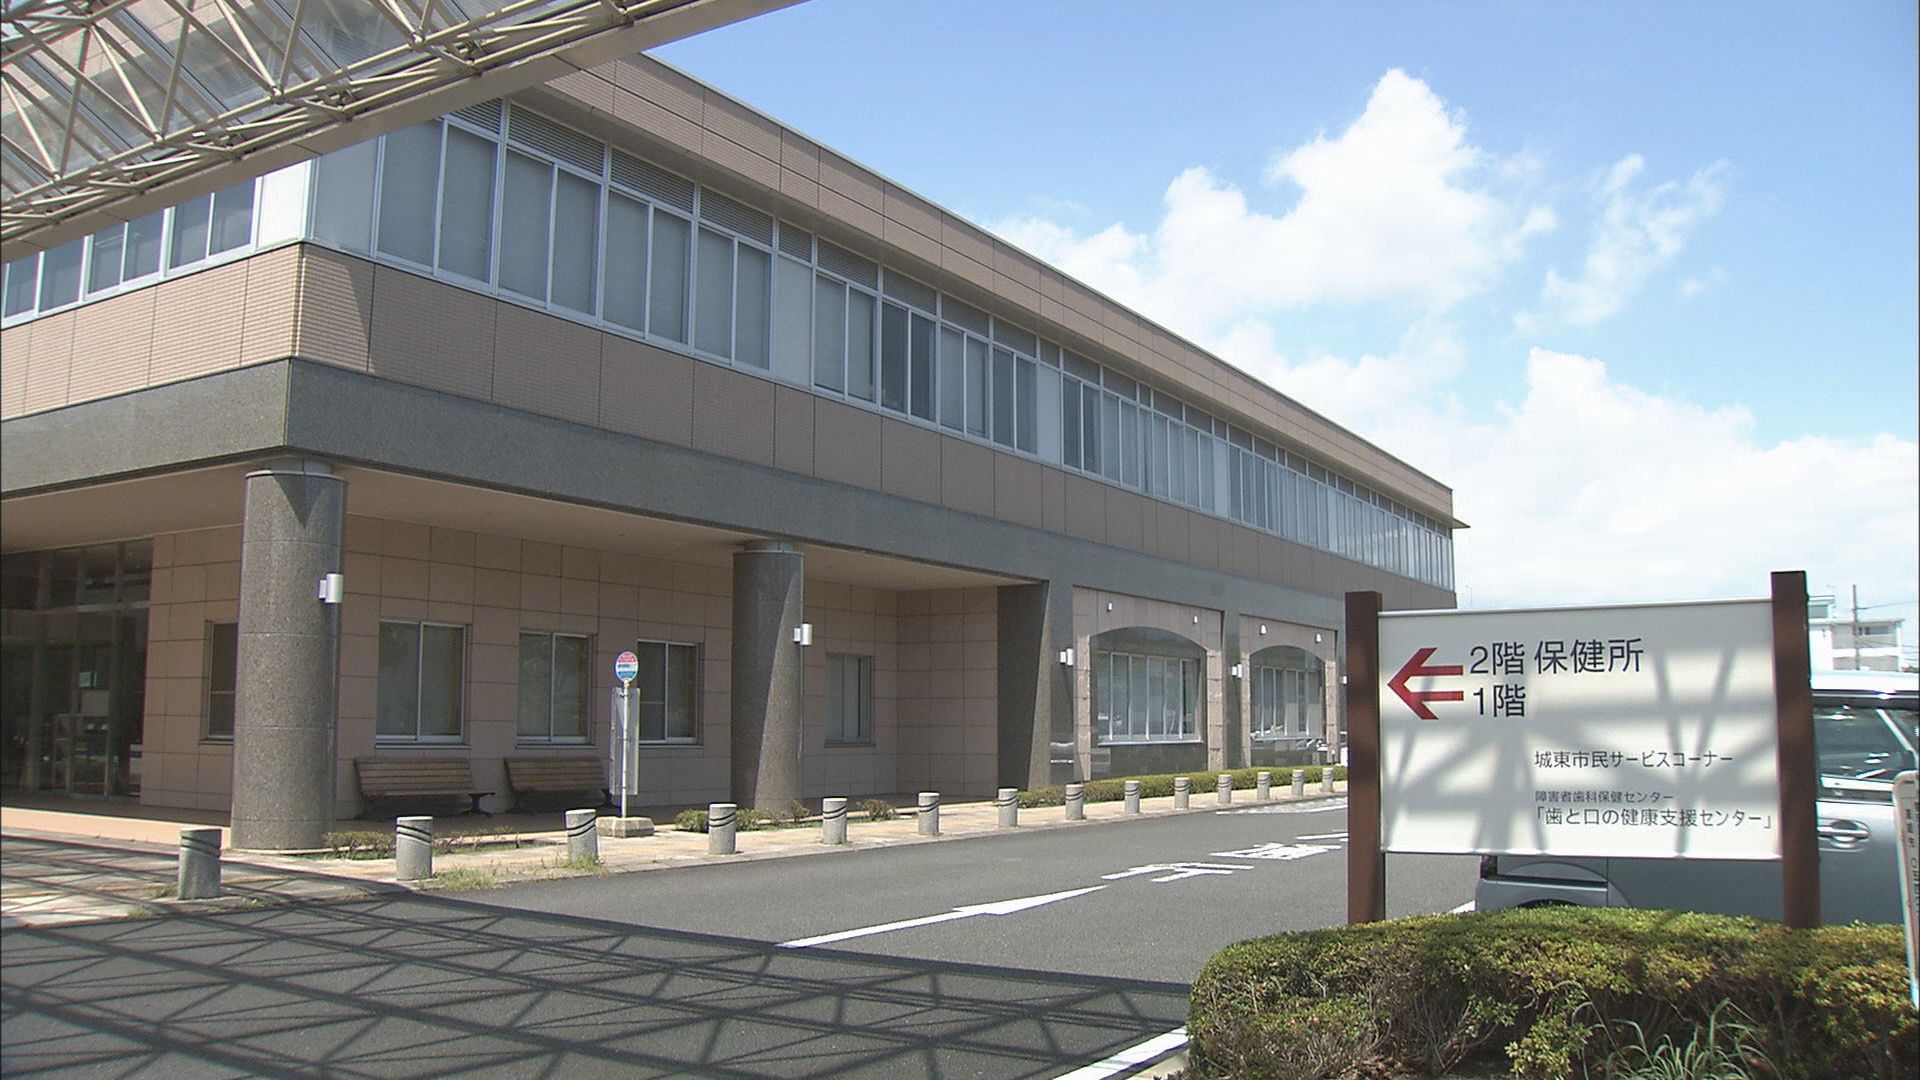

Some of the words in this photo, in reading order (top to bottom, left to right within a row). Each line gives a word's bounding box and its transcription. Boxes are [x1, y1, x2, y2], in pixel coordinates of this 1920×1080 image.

[1470, 641, 1525, 675] 2階
[1534, 637, 1644, 674] 保健所
[1473, 684, 1526, 718] 1階
[1534, 750, 1733, 769] 城東市民サービスコーナー
[1534, 790, 1674, 804] 障害者歯科保健センター
[1537, 807, 1772, 829] 「歯と口の健康支援センター」
